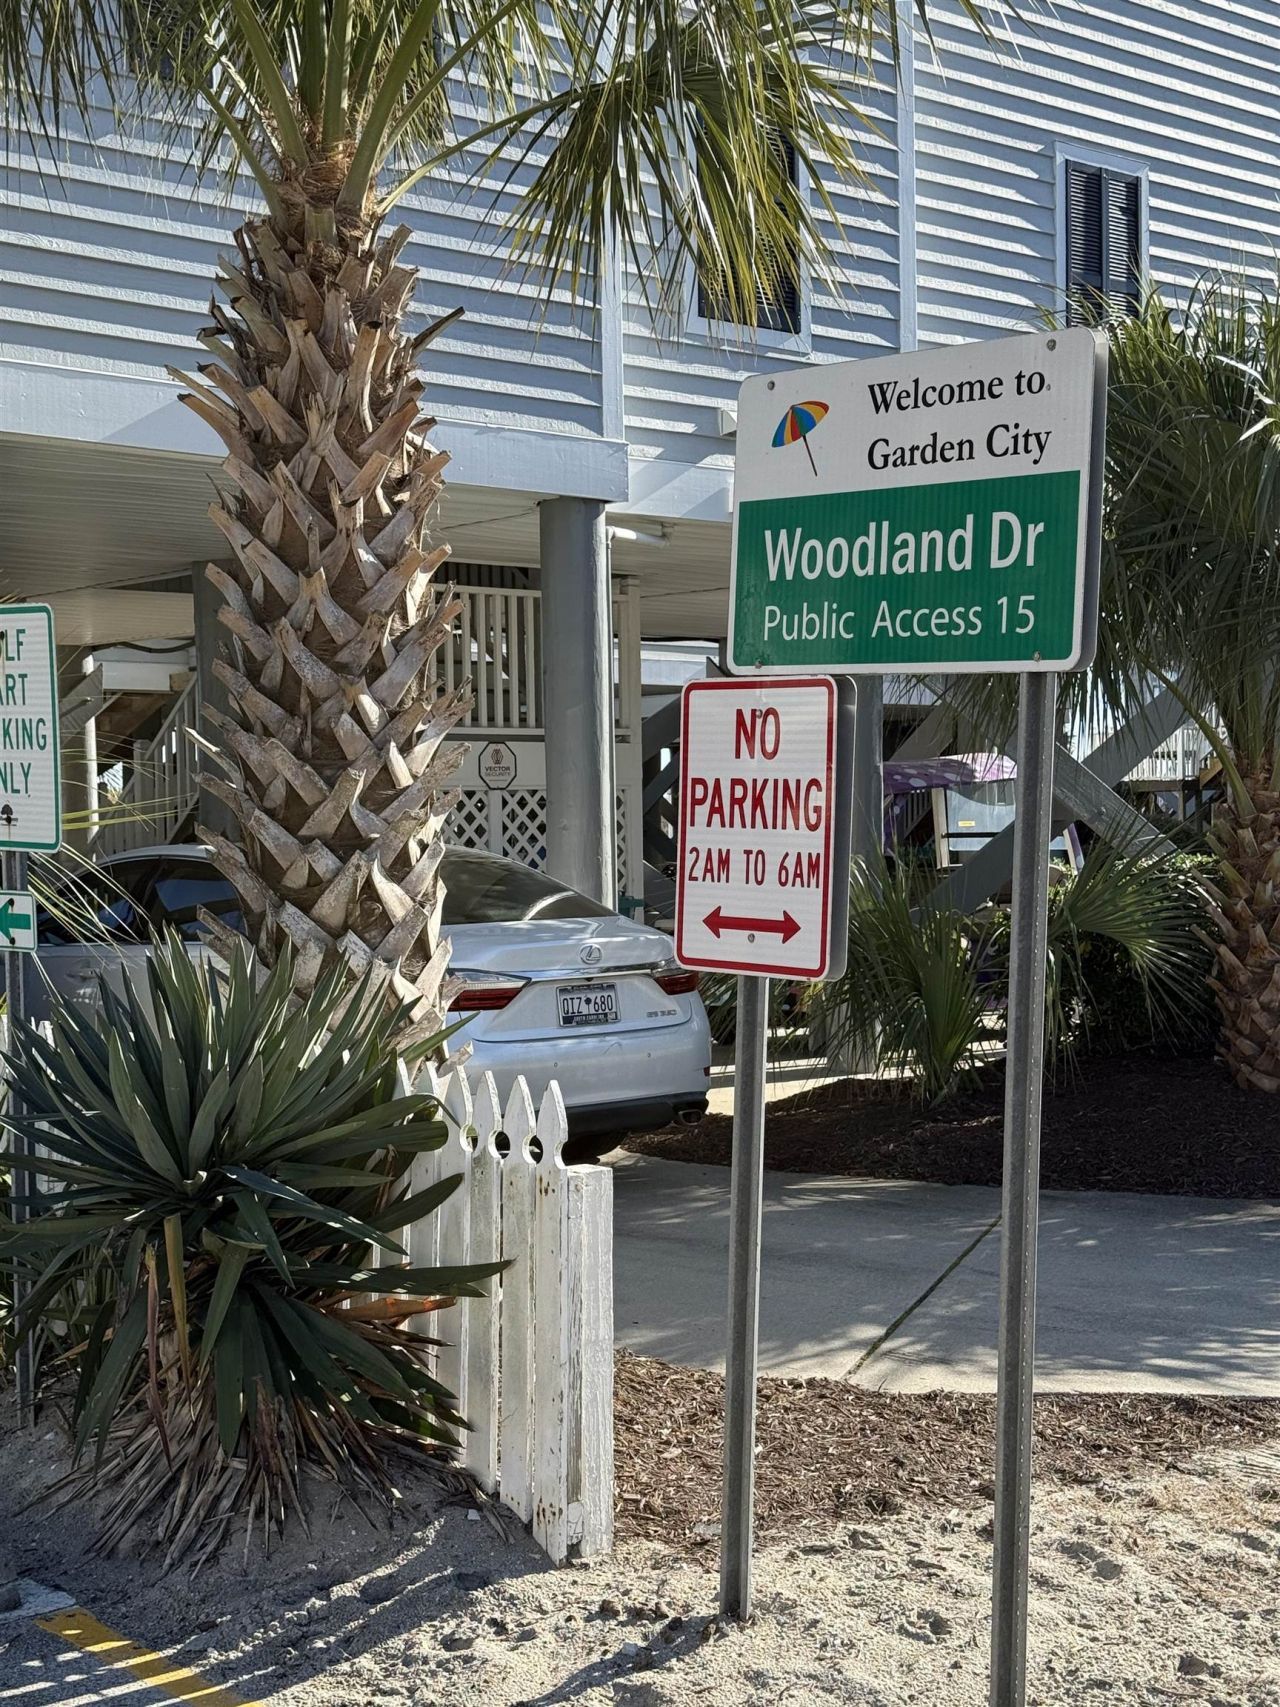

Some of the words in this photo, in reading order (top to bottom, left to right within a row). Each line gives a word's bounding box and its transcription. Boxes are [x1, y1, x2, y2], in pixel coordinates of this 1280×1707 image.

[867, 375, 1004, 415] Welcome
[1015, 369, 1046, 395] to
[867, 432, 975, 470] Garden
[986, 423, 1052, 466] City
[764, 513, 974, 582] Woodland
[990, 511, 1045, 570] Dr
[763, 602, 855, 641] Public
[872, 600, 982, 638] Access
[997, 595, 1036, 634] 15
[0, 629, 26, 661] LF
[0, 673, 28, 706] RT
[2, 717, 48, 751] KING
[734, 707, 781, 760] NO
[0, 762, 32, 794] NLY
[689, 777, 823, 832] PARKING
[688, 846, 731, 883] 2AM
[743, 849, 766, 886] TO
[777, 851, 821, 889] 6AM
[593, 994, 613, 1012] 680
